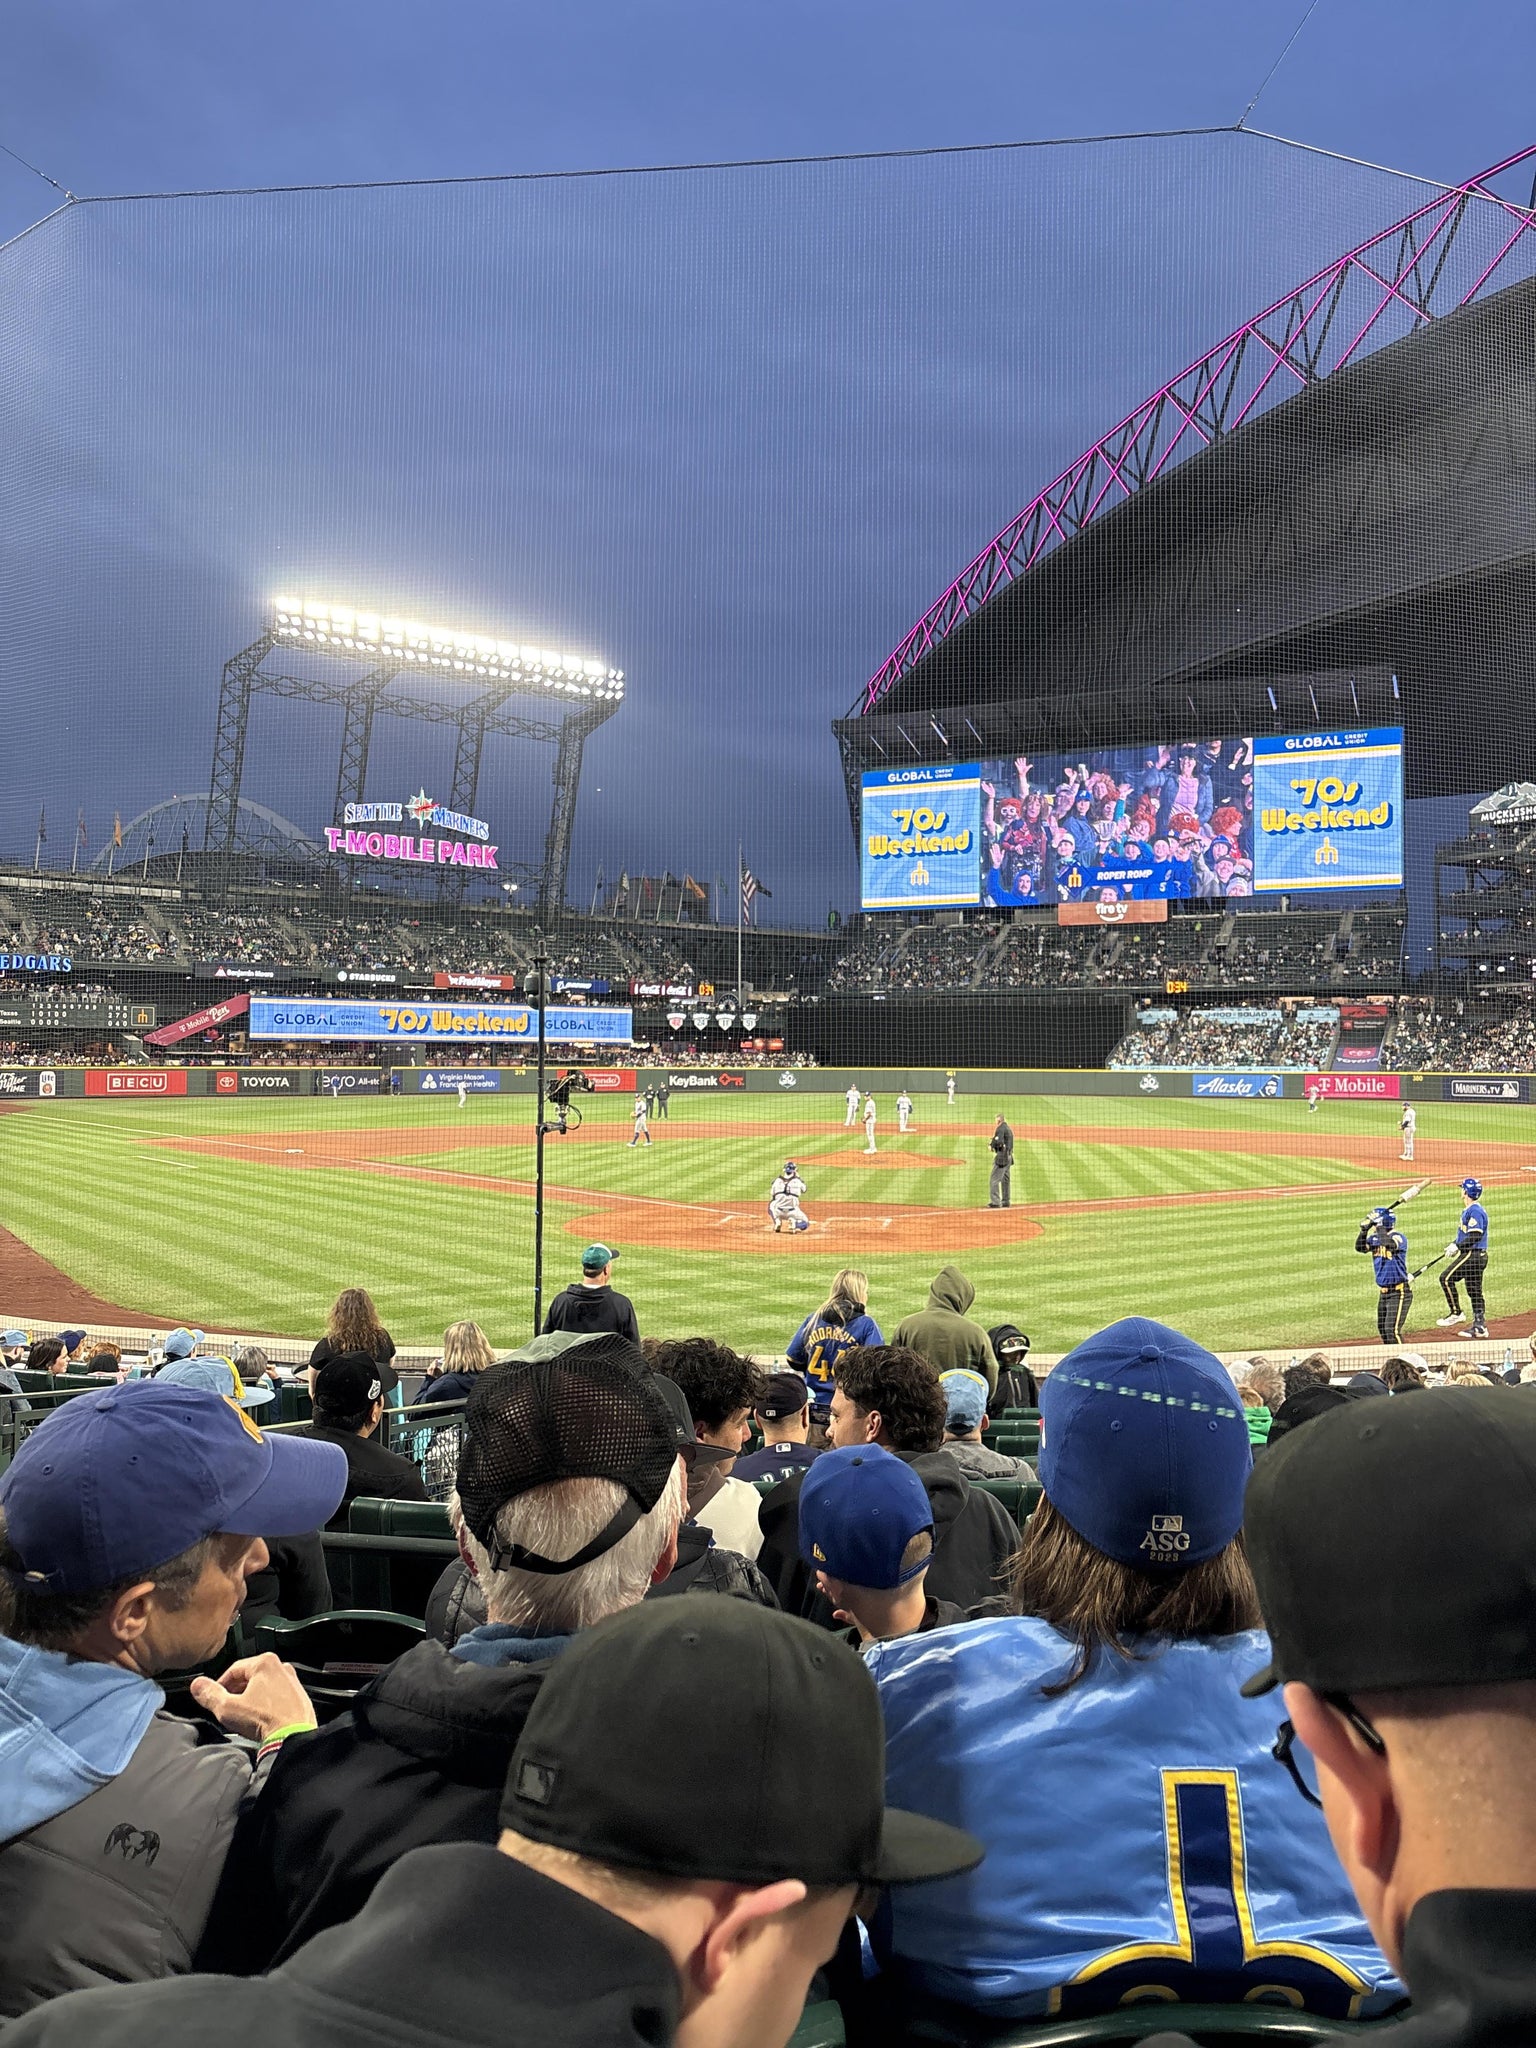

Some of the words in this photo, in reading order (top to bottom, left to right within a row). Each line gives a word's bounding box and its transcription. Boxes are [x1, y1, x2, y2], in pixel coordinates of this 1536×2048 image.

[1285, 735, 1342, 750] GLOBAL
[887, 770, 934, 783] GLOBAL
[344, 803, 402, 823] SEATTLE
[432, 807, 489, 840] MARINERS
[1261, 801, 1393, 835] Weekend
[324, 827, 435, 862] T-MOBILE
[438, 840, 499, 869] PARK
[868, 829, 973, 858] Weekend
[1096, 870, 1126, 880] ROPER
[1127, 869, 1153, 879] ROMP
[1095, 903, 1115, 914] fire
[1115, 903, 1129, 913] tv
[350, 973, 396, 983] STARBUCKS
[186, 1016, 210, 1030] Mobile
[274, 1013, 337, 1026] GLOBAL
[432, 1009, 530, 1033] Weekend
[545, 1019, 594, 1030] GLOBAL
[242, 1077, 290, 1087] TOYOTA
[439, 1073, 463, 1082] Virginia
[474, 1080, 496, 1088] Health
[669, 1074, 718, 1088] KeyBank
[6, 1084, 26, 1092] TIME
[1197, 1077, 1253, 1095] Alaska
[1335, 1077, 1386, 1092] Mobile
[1140, 1531, 1190, 1551] ASG
[1150, 1551, 1179, 1562] 2023
